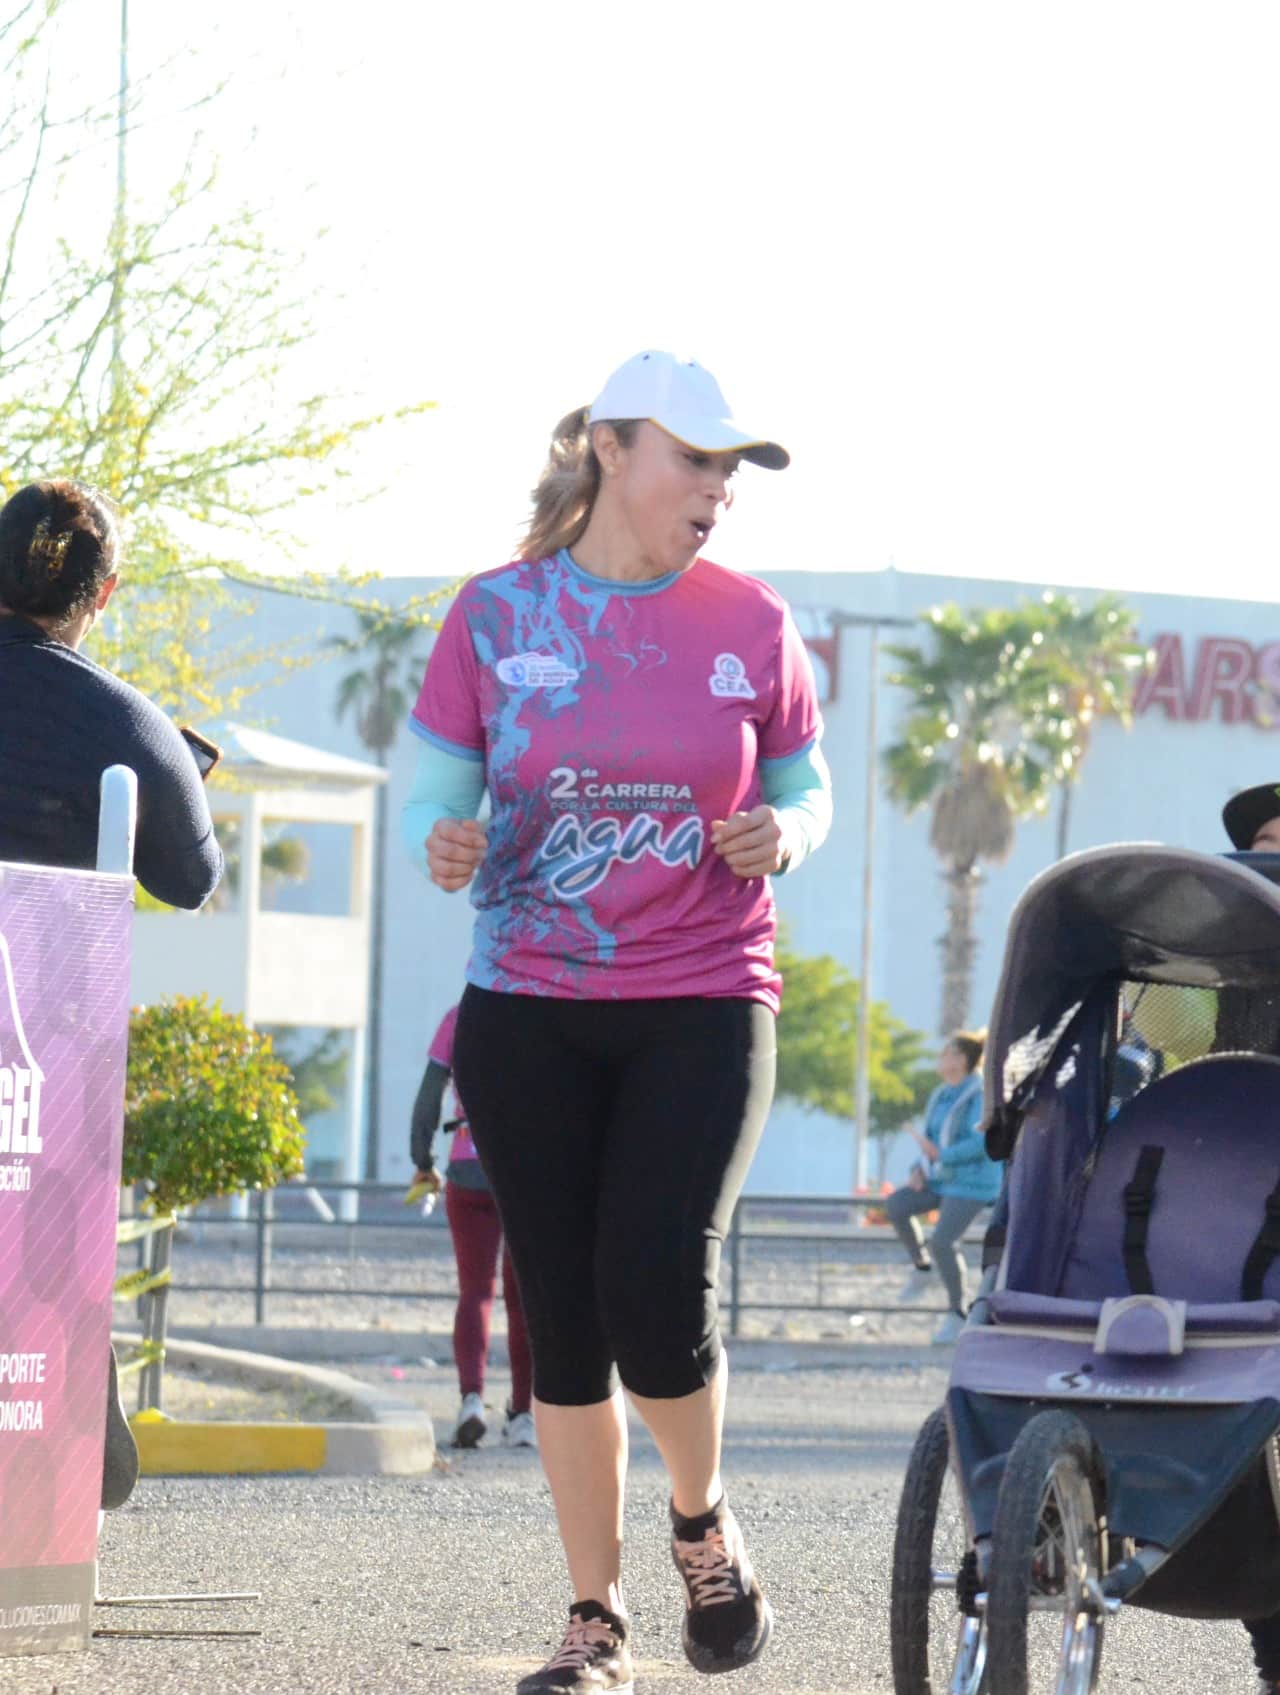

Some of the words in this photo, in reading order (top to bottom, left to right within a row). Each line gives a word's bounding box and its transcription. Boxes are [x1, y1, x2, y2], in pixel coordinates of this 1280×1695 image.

[584, 783, 692, 799] CARRERA
[605, 801, 669, 813] CULTURA
[541, 813, 704, 899] agua
